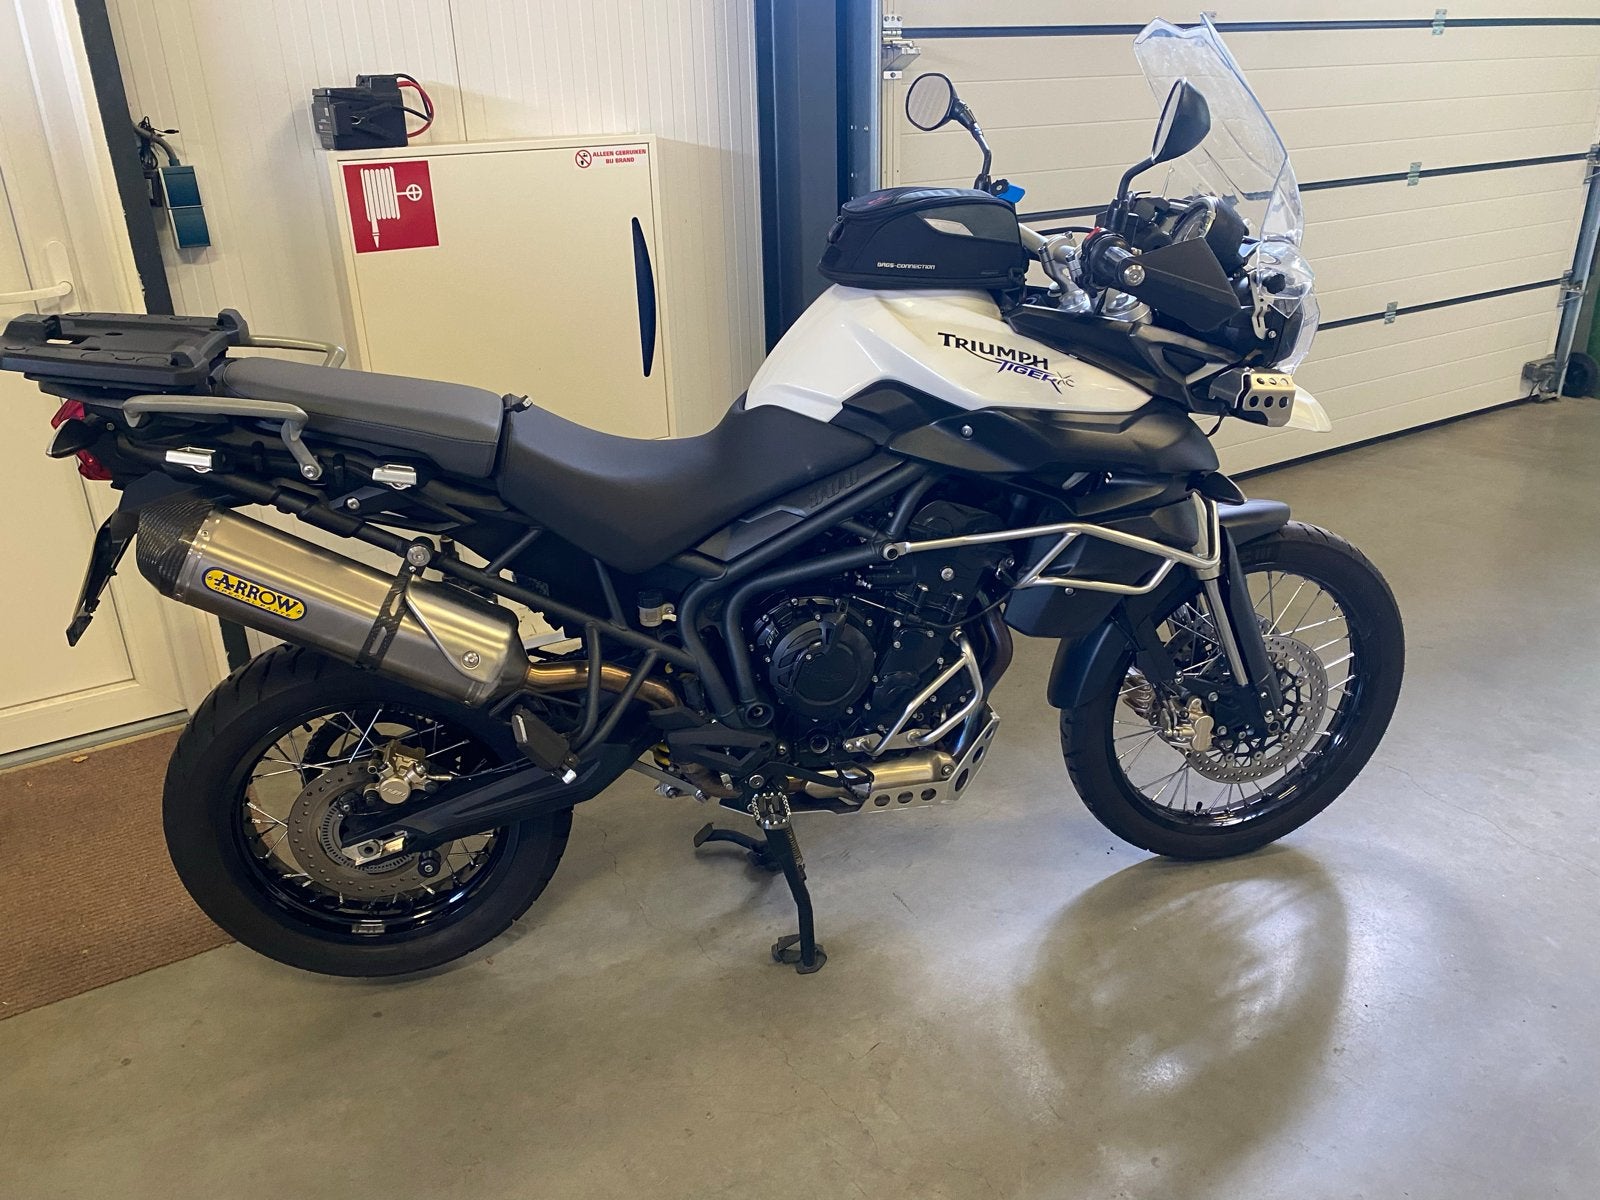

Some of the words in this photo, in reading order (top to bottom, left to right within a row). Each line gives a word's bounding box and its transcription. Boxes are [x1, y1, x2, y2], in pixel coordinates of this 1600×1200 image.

[615, 148, 647, 156] GEBRUIKEN
[937, 331, 1049, 370] TRIUMPH
[995, 357, 1063, 395] TIGER
[214, 574, 299, 613] ARROW
[214, 586, 256, 605] SPECIAL
[260, 603, 292, 617] PARTS
